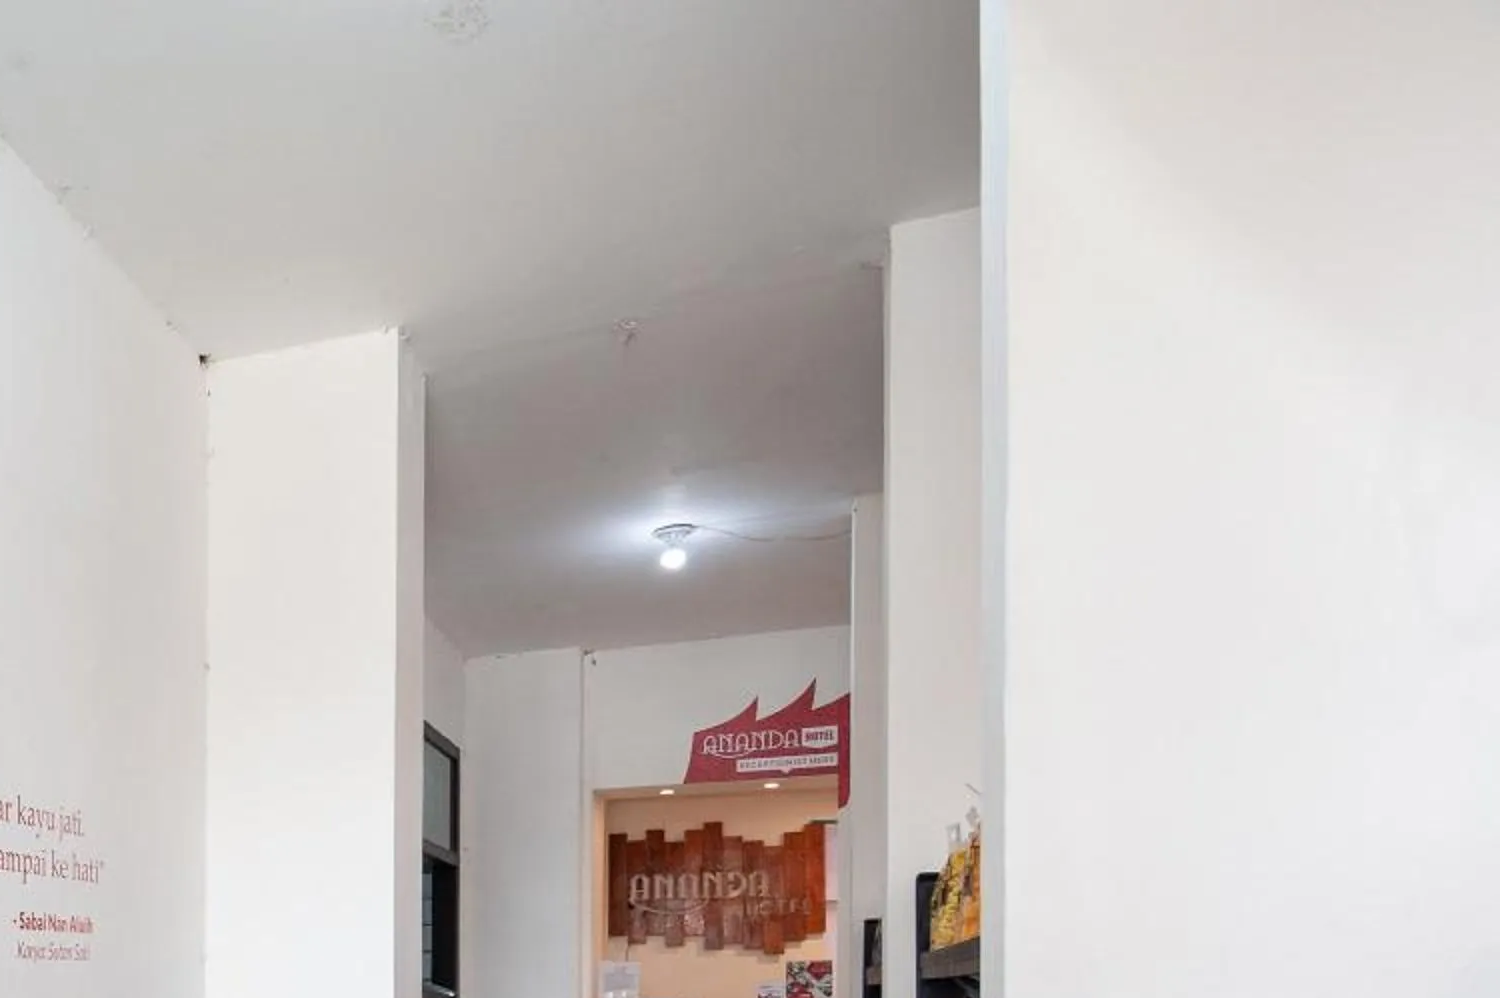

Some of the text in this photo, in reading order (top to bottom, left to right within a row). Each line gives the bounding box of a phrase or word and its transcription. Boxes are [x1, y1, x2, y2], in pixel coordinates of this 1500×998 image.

[702, 729, 835, 759] ANANDA HOTEL
[16, 794, 57, 839] kayu
[51, 849, 69, 879] ke
[628, 871, 771, 914] ANANDA
